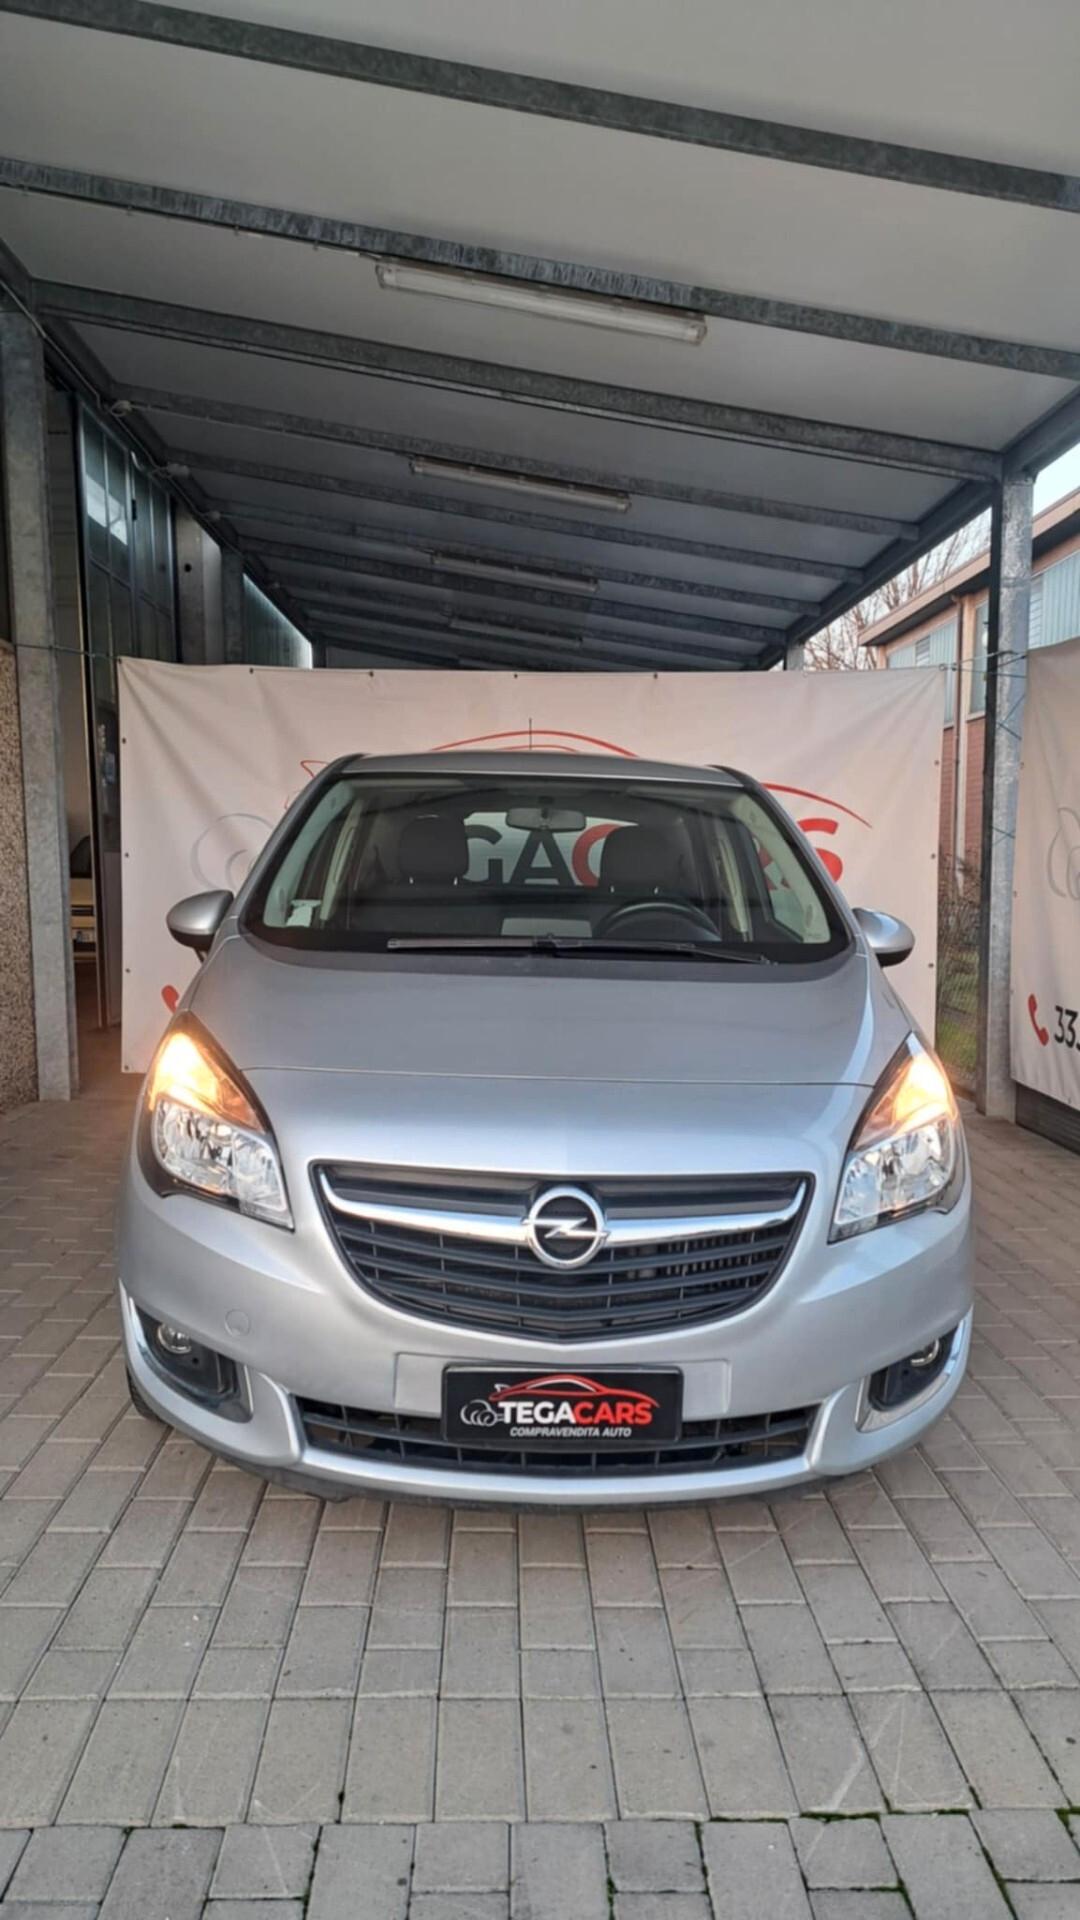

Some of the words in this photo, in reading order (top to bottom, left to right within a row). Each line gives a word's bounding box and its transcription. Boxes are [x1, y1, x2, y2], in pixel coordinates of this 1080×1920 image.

[1054, 1005, 1080, 1051] 33
[498, 1401, 652, 1425] TEGACARS
[509, 1426, 600, 1437] COMPRAVENDITA
[602, 1427, 632, 1437] AUTO
